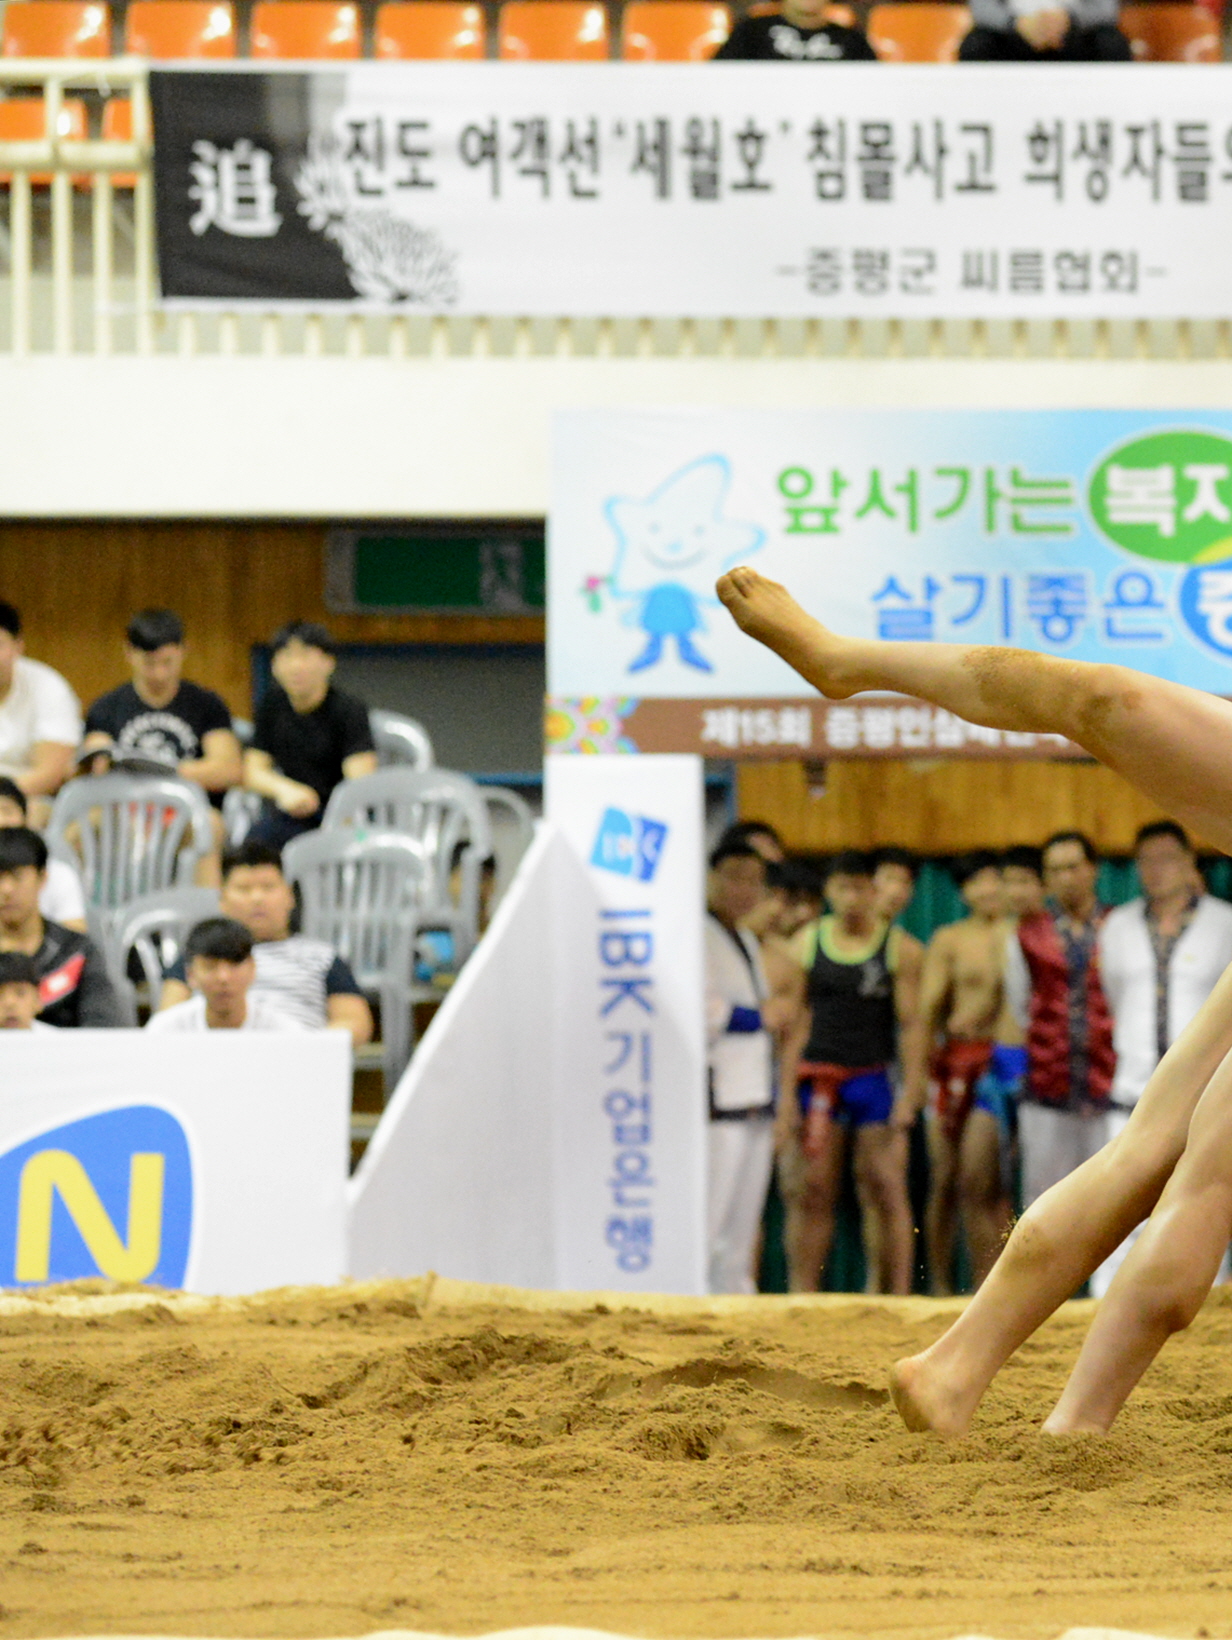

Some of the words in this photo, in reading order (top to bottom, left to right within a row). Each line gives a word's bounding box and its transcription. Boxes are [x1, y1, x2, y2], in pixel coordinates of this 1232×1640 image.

[188, 139, 283, 237] 追
[343, 118, 436, 196] 진도
[459, 116, 599, 199] 여객선
[807, 119, 996, 202] 침몰사고
[776, 466, 1074, 536] 앞서가는
[870, 572, 1167, 644] 살기좋은
[599, 909, 656, 1018] IBK
